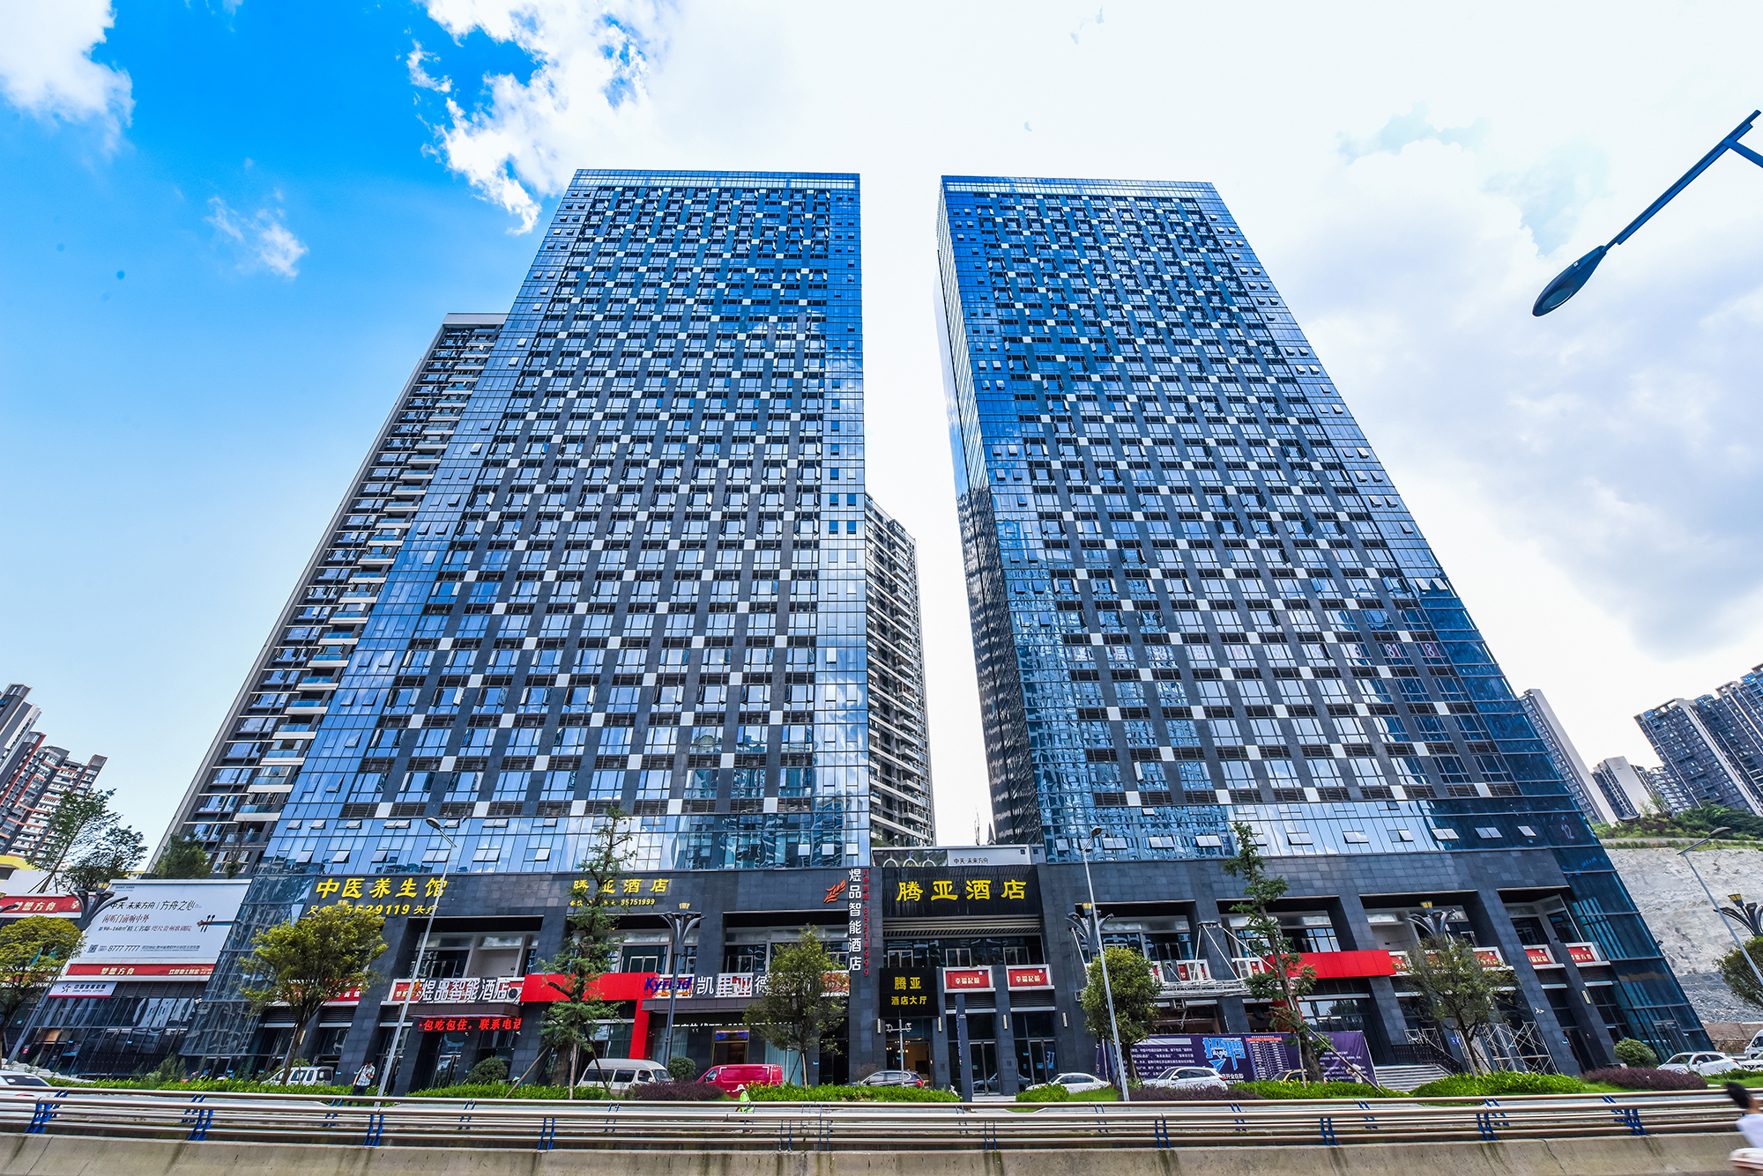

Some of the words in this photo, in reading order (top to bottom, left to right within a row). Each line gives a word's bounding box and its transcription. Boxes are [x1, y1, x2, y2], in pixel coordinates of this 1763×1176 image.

[316, 877, 448, 899] 中医养生馆
[573, 878, 669, 894] 腾亚酒店
[896, 879, 1027, 901] 腾亚酒店
[848, 868, 862, 971] 煜品智能酒店
[420, 979, 510, 1001] 煜品智能酒店
[894, 976, 922, 990] 腾亚
[891, 995, 927, 1006] 酒店大厅
